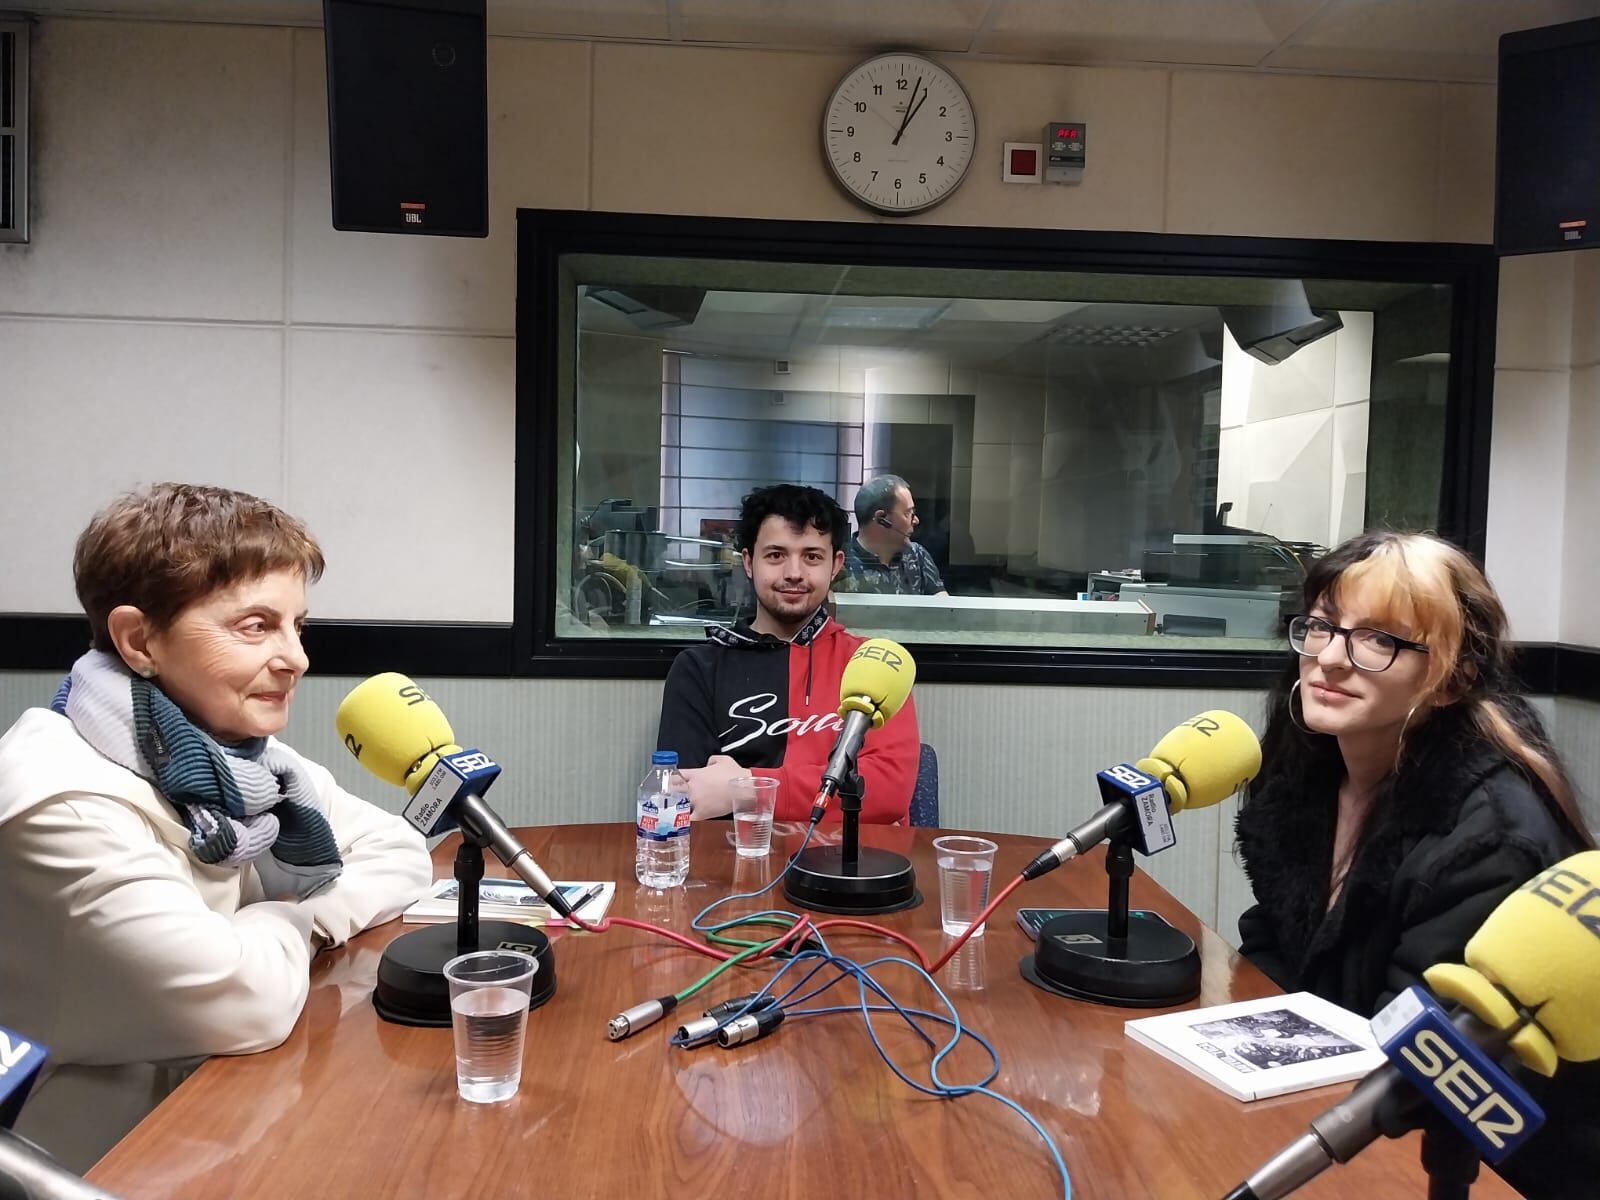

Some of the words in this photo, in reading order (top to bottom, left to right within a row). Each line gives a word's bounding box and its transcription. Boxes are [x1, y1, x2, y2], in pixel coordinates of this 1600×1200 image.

[873, 84, 883, 96] 11
[896, 79, 908, 90] 12
[854, 101, 867, 113] 10
[939, 106, 947, 117] 2
[847, 126, 855, 137] 9
[945, 131, 953, 142] 3
[853, 151, 861, 163] 8
[936, 155, 945, 167] 4
[871, 170, 879, 181] 7
[918, 173, 927, 184] 5
[894, 178, 902, 190] 6
[451, 753, 496, 774] SER
[1104, 765, 1151, 789] SER
[414, 803, 430, 822] Radio
[420, 797, 443, 827] ZAMORA
[1400, 1029, 1525, 1149] SER
